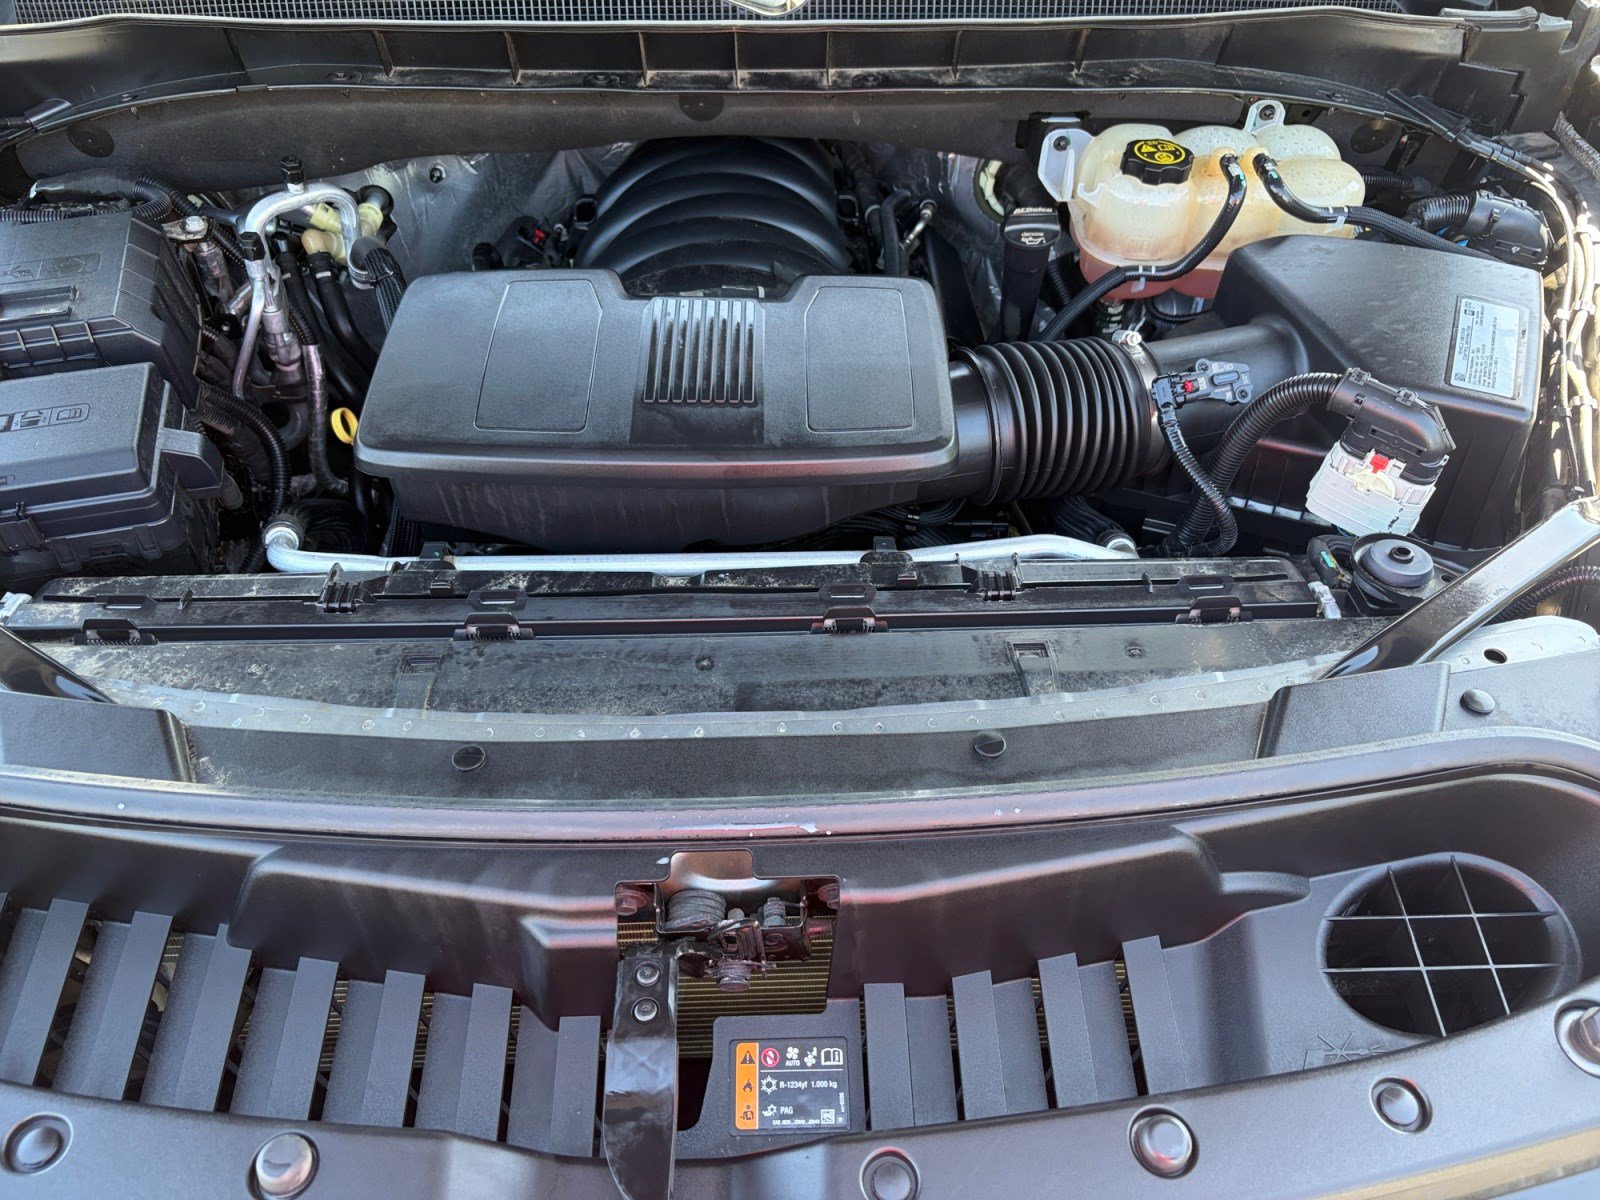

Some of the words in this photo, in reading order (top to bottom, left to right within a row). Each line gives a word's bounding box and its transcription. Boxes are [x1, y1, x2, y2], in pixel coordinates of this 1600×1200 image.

[1013, 207, 1052, 215] ACDelco
[780, 1081, 808, 1090] R-1234yf
[829, 1080, 838, 1089] kg
[780, 1106, 793, 1114] PAG
